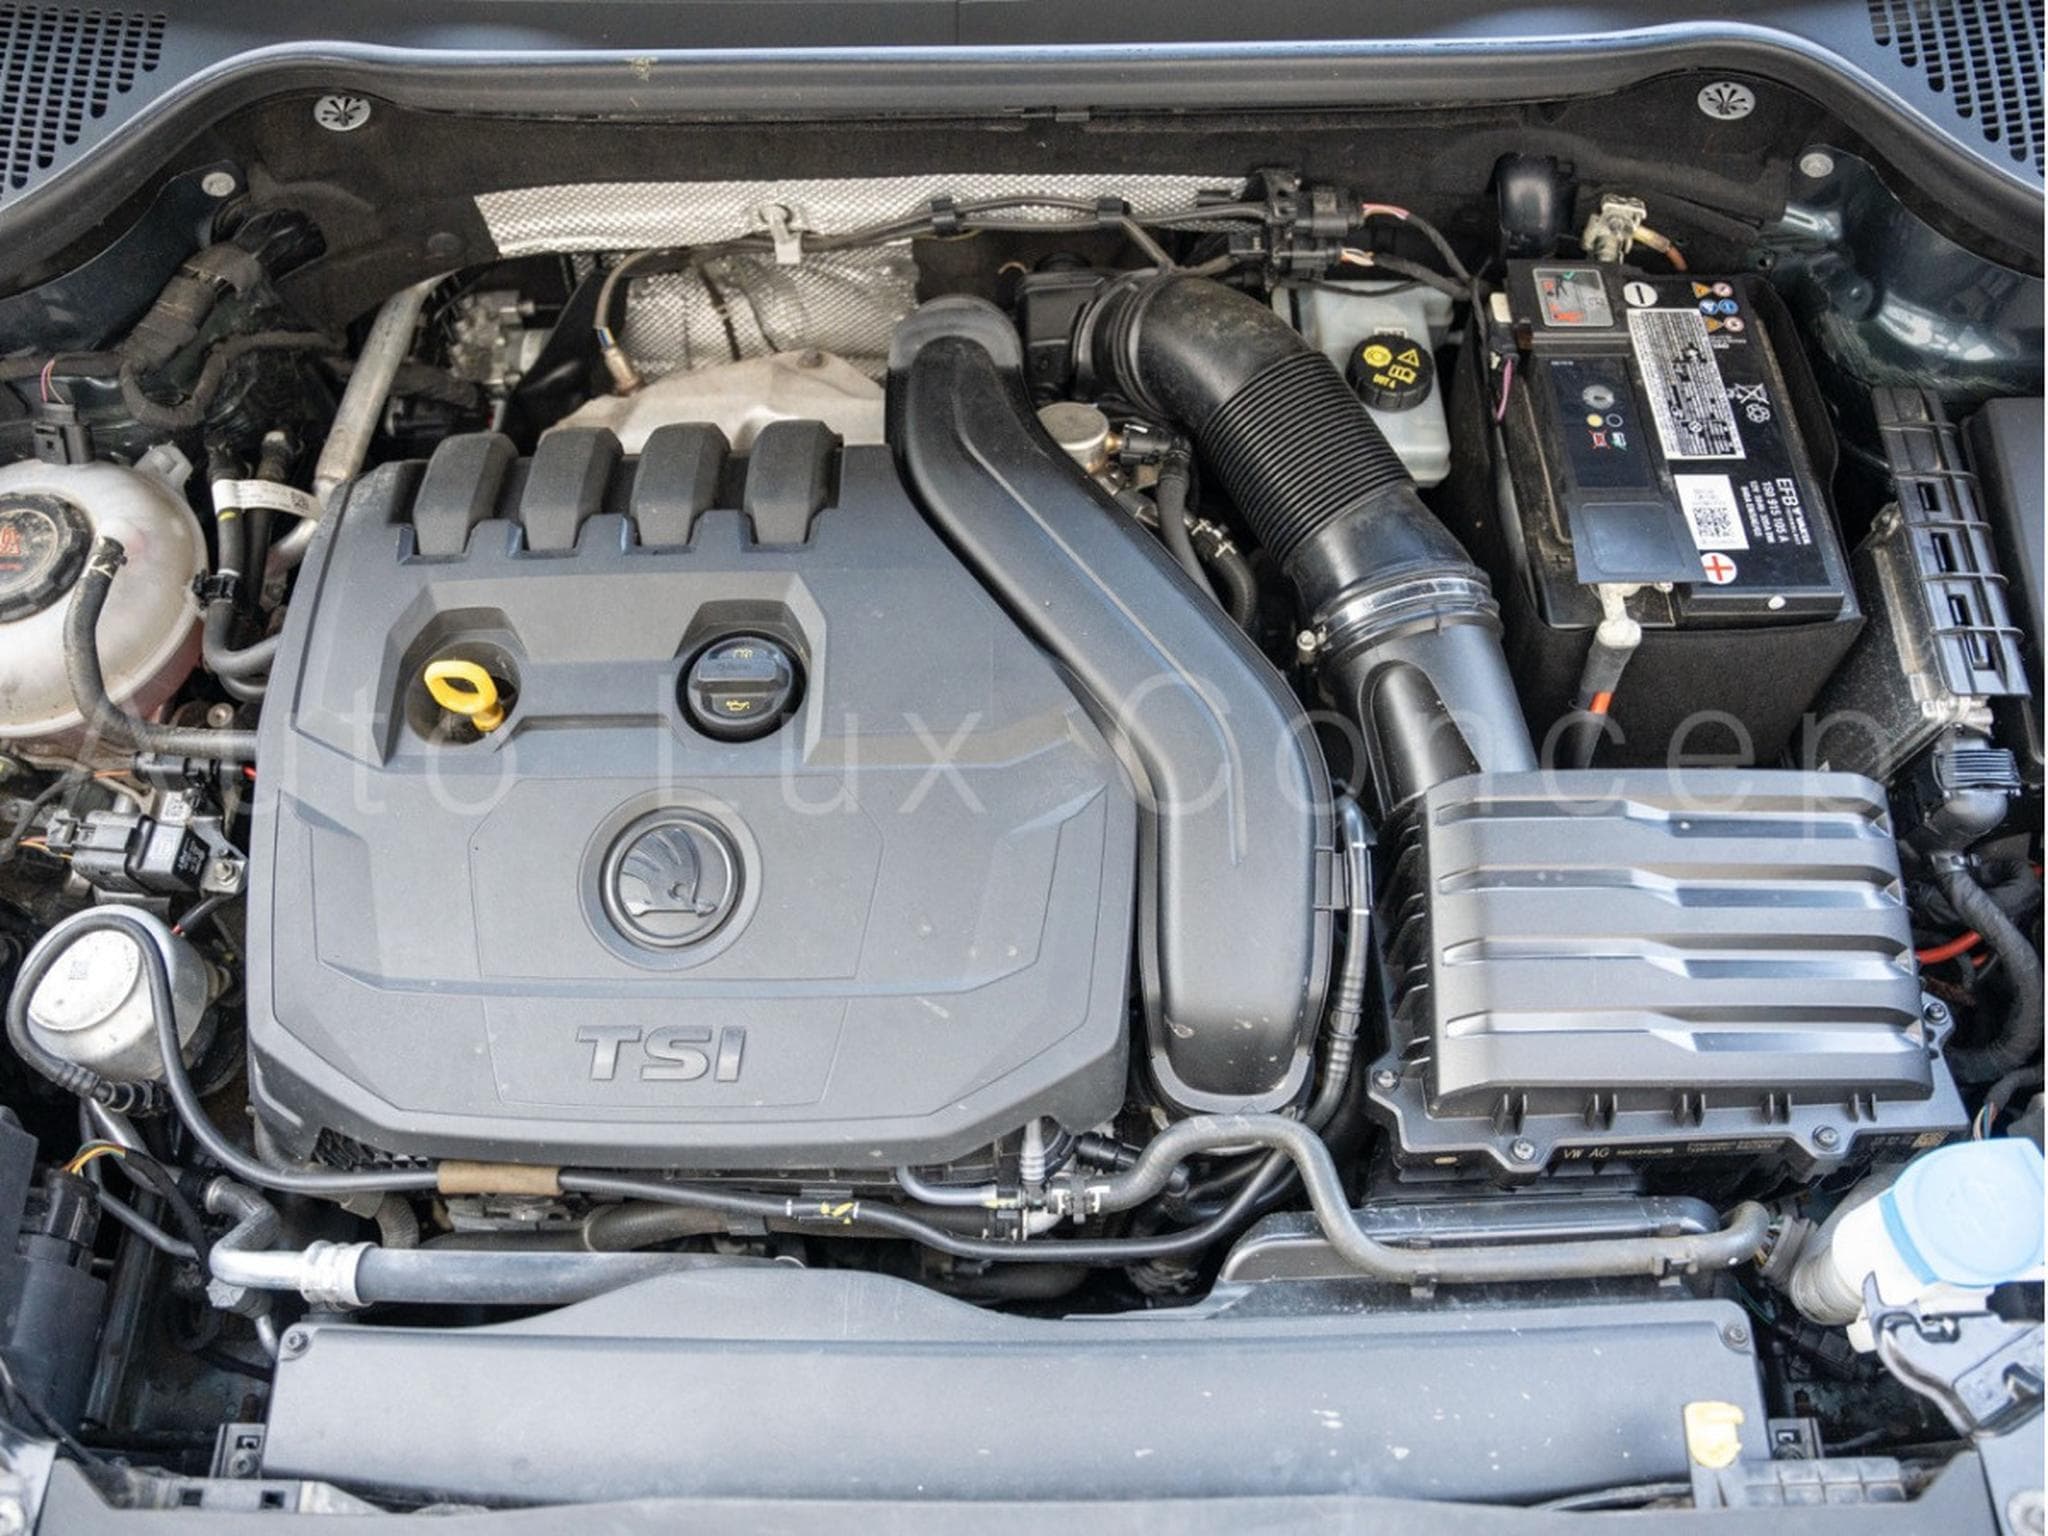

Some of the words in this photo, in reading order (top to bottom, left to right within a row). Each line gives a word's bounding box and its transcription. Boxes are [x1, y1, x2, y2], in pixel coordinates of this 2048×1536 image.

[1776, 478, 1799, 506] EFB
[576, 1025, 746, 1083] TSI
[1563, 1148, 1584, 1159] VW
[1588, 1147, 1610, 1158] AG
